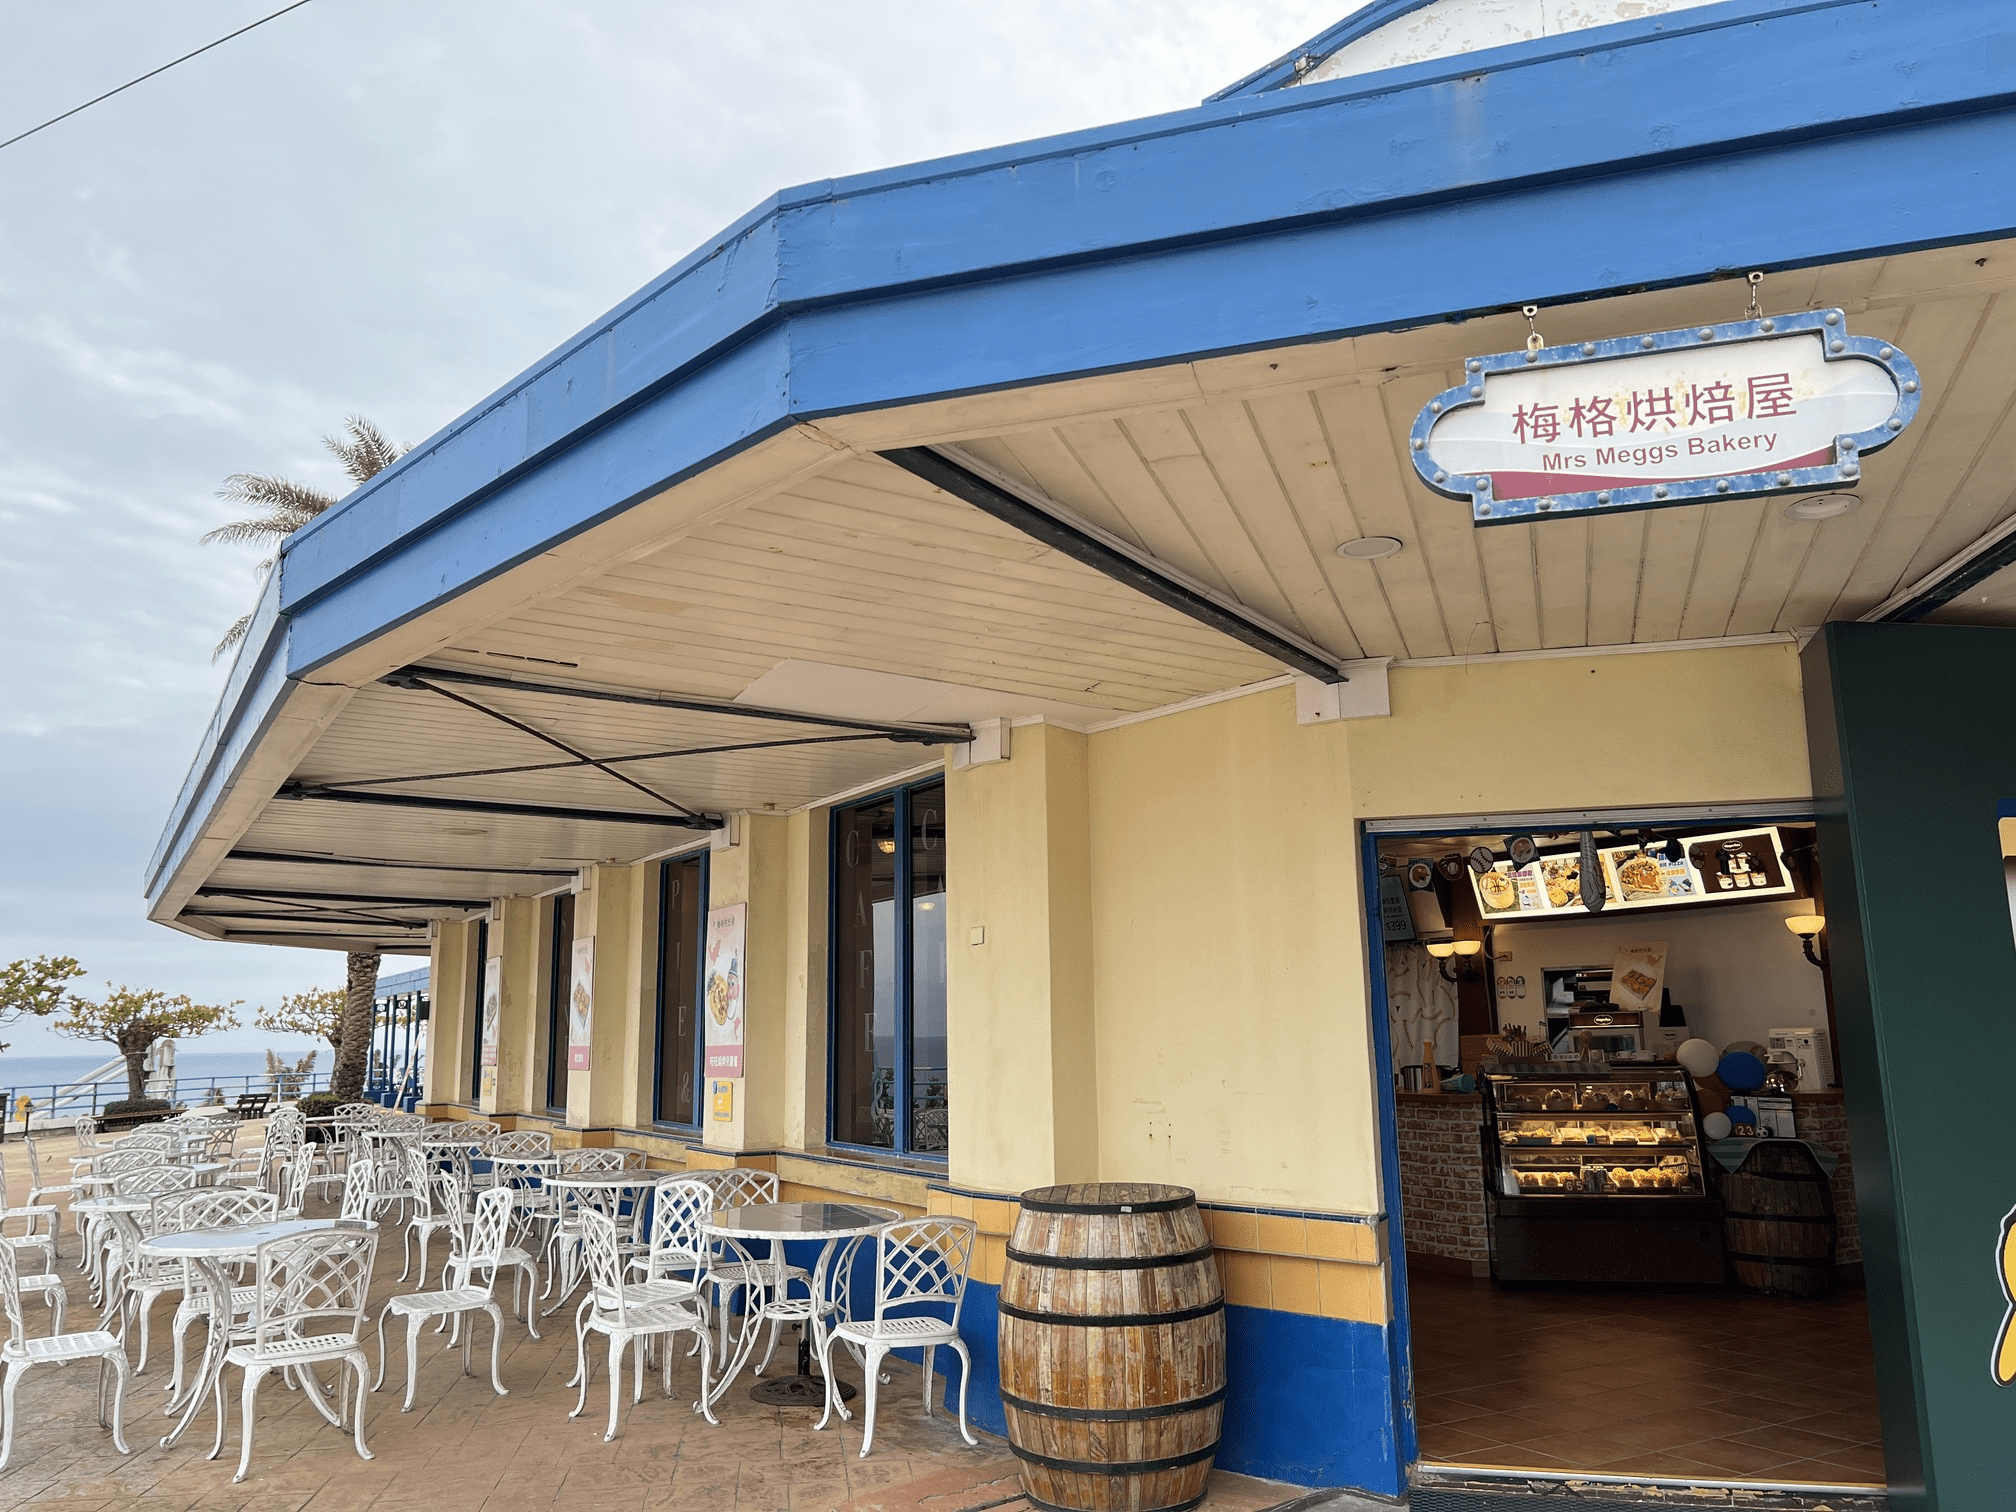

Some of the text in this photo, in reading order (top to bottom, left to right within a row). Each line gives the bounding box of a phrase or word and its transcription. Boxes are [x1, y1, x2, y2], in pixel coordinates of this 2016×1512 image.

[1511, 372, 1798, 445] 梅格烘焙屋
[1541, 429, 1779, 471] Mrs Meggs Bakery
